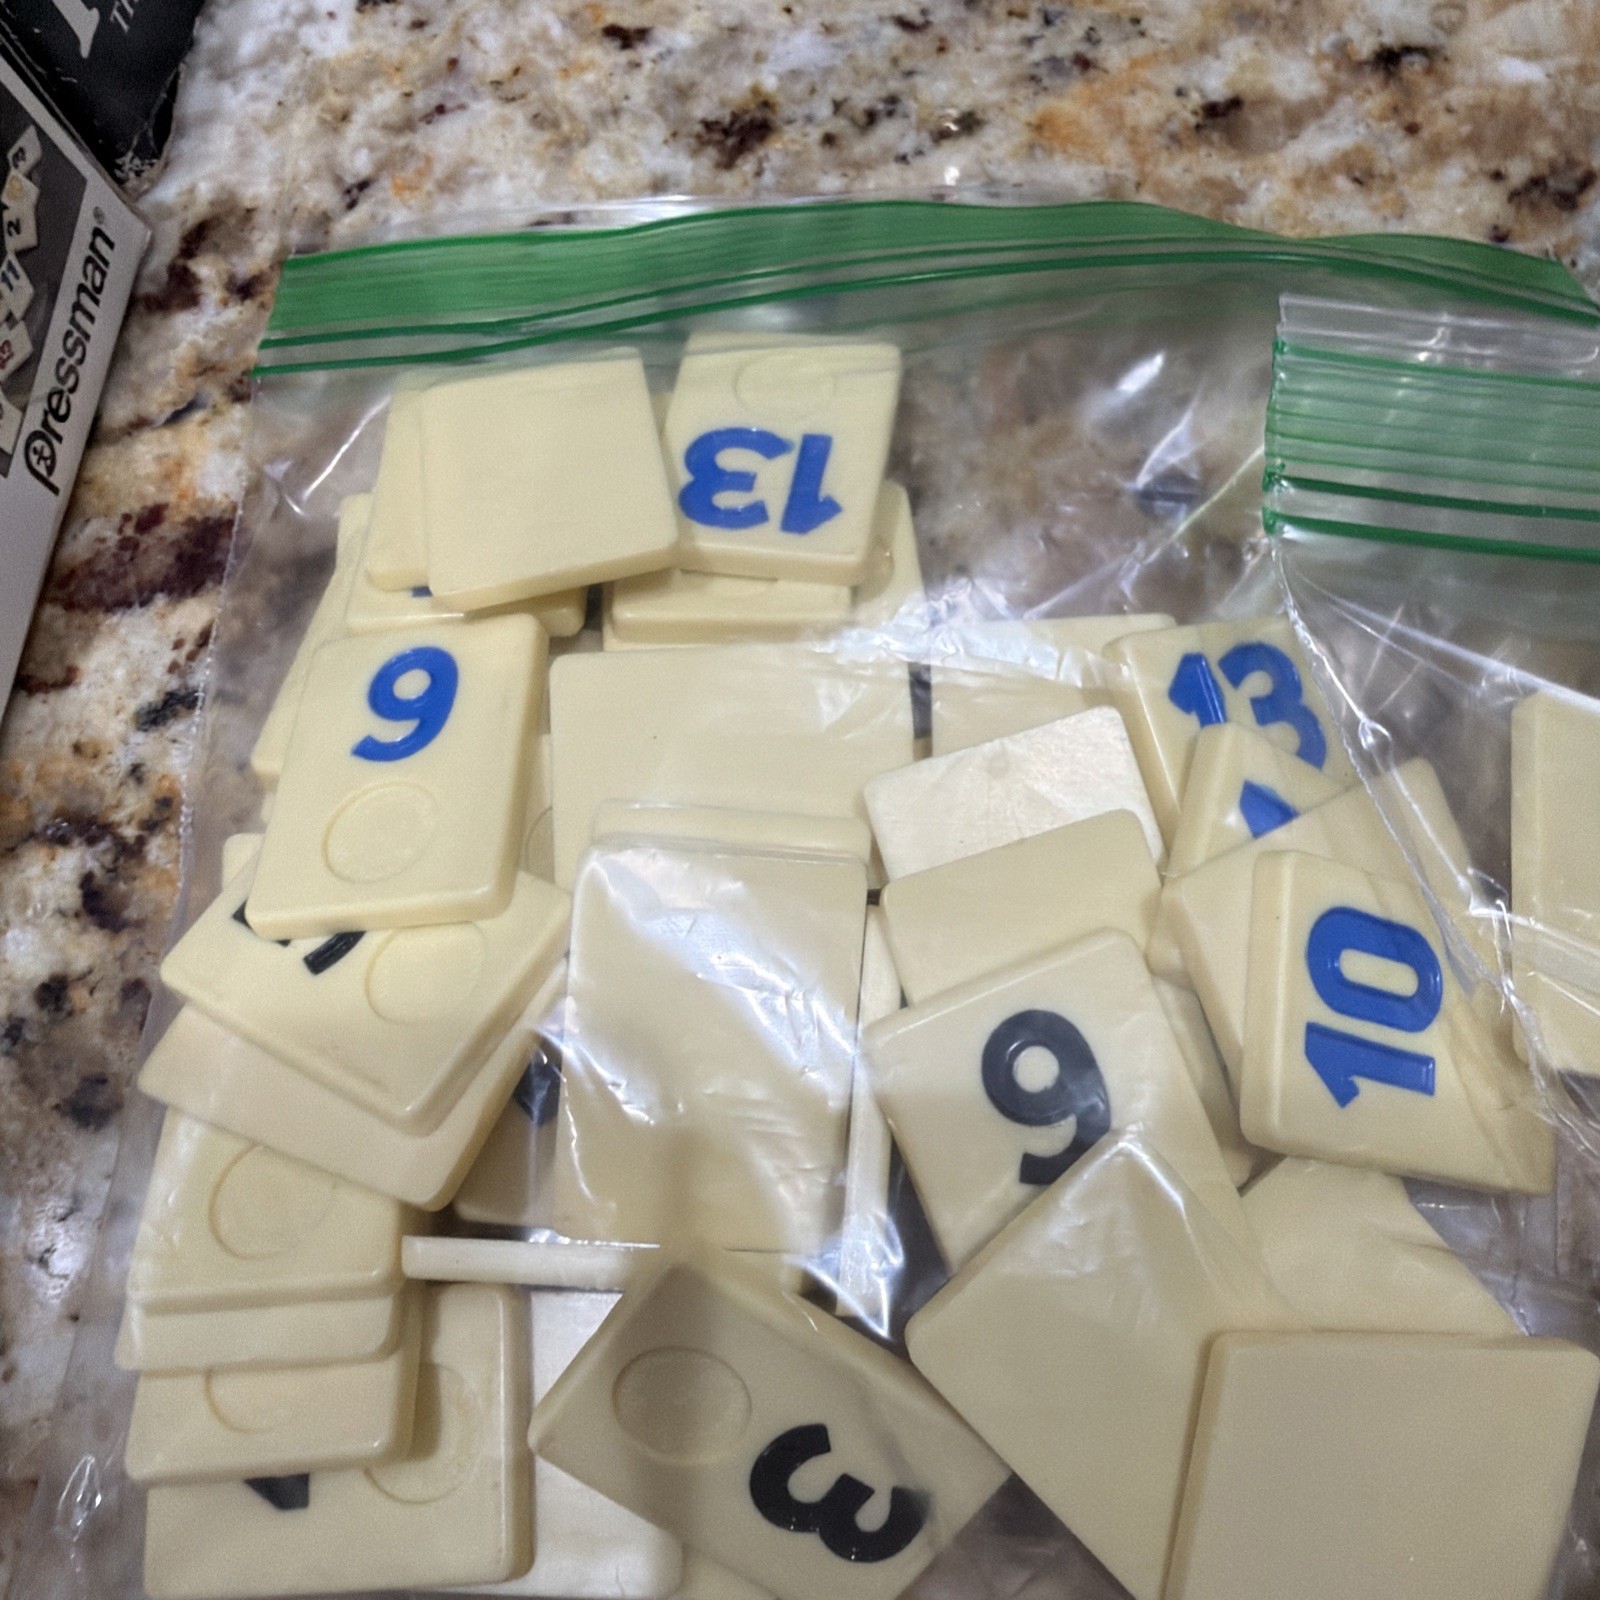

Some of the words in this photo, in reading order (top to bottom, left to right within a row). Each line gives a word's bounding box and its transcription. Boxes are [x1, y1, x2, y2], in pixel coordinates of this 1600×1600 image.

[7, 219, 20, 236] 2
[680, 428, 842, 534] 13
[351, 647, 459, 762] 9
[1168, 643, 1327, 770] 13
[1305, 906, 1444, 1108] 10
[981, 1010, 1110, 1191] 9
[749, 1423, 931, 1563] 3
